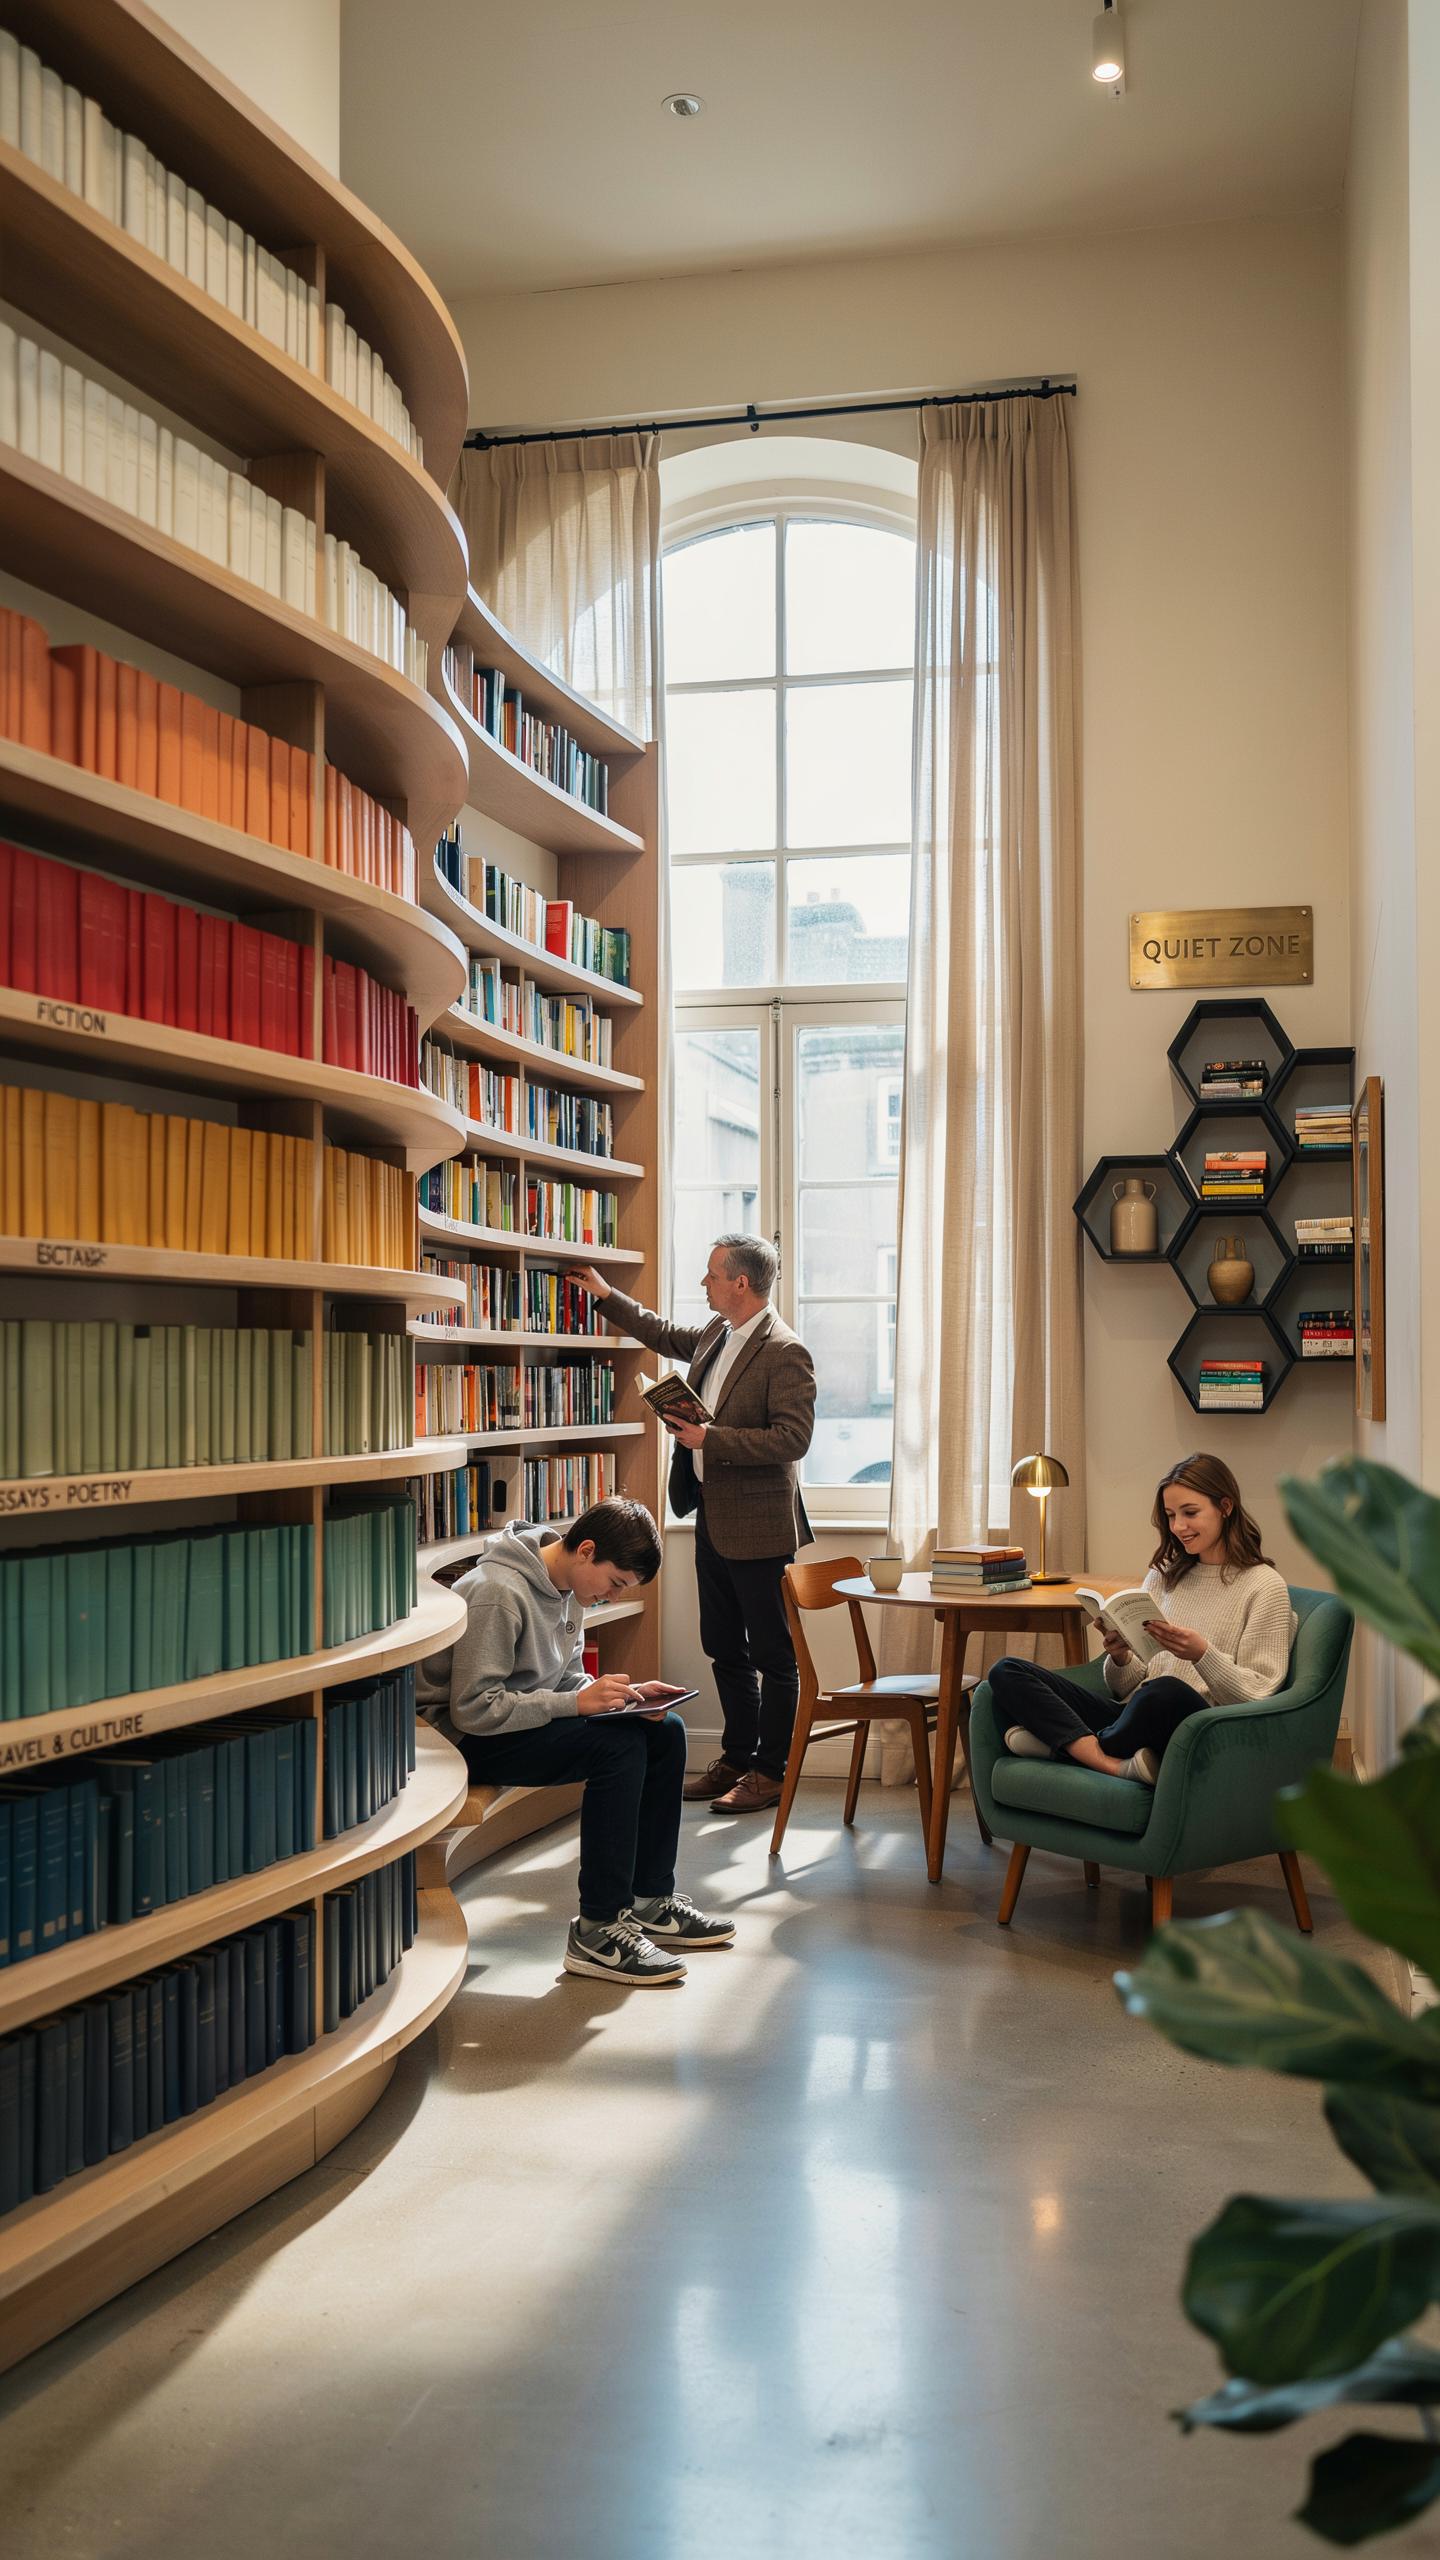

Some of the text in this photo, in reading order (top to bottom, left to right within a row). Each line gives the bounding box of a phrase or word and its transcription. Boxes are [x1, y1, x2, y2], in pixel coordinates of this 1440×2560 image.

[1142, 935, 1300, 964] QUIET ZONE
[36, 1001, 107, 1034] FICTION
[66, 1480, 132, 1504] POETRY
[0, 1714, 144, 1768] AVEL & CULTURE
